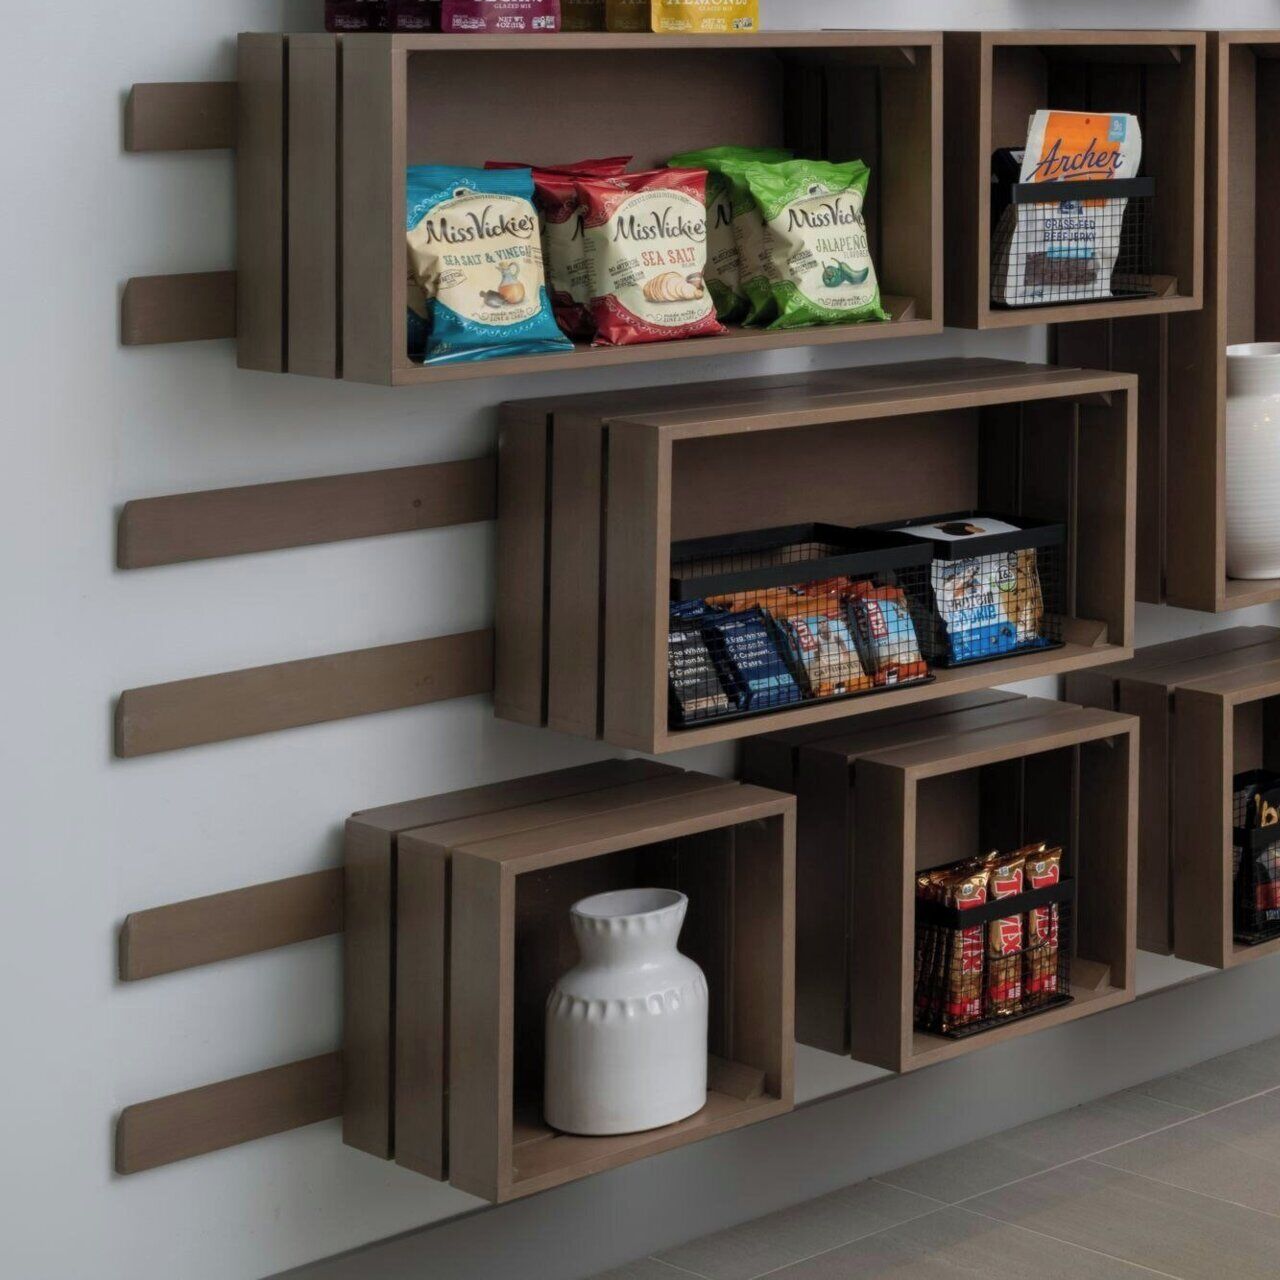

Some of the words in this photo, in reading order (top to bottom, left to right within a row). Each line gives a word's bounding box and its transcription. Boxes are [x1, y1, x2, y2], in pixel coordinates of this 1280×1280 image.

[1026, 137, 1126, 181] Archer
[1045, 219, 1096, 230] GRASS-FED
[1044, 231, 1069, 241] BEEF
[816, 235, 867, 253] JALAPEÑO
[443, 255, 461, 266] SEA
[460, 253, 482, 266] SALT
[485, 254, 495, 263] &
[641, 251, 665, 267] SEA
[668, 247, 695, 265] SALT
